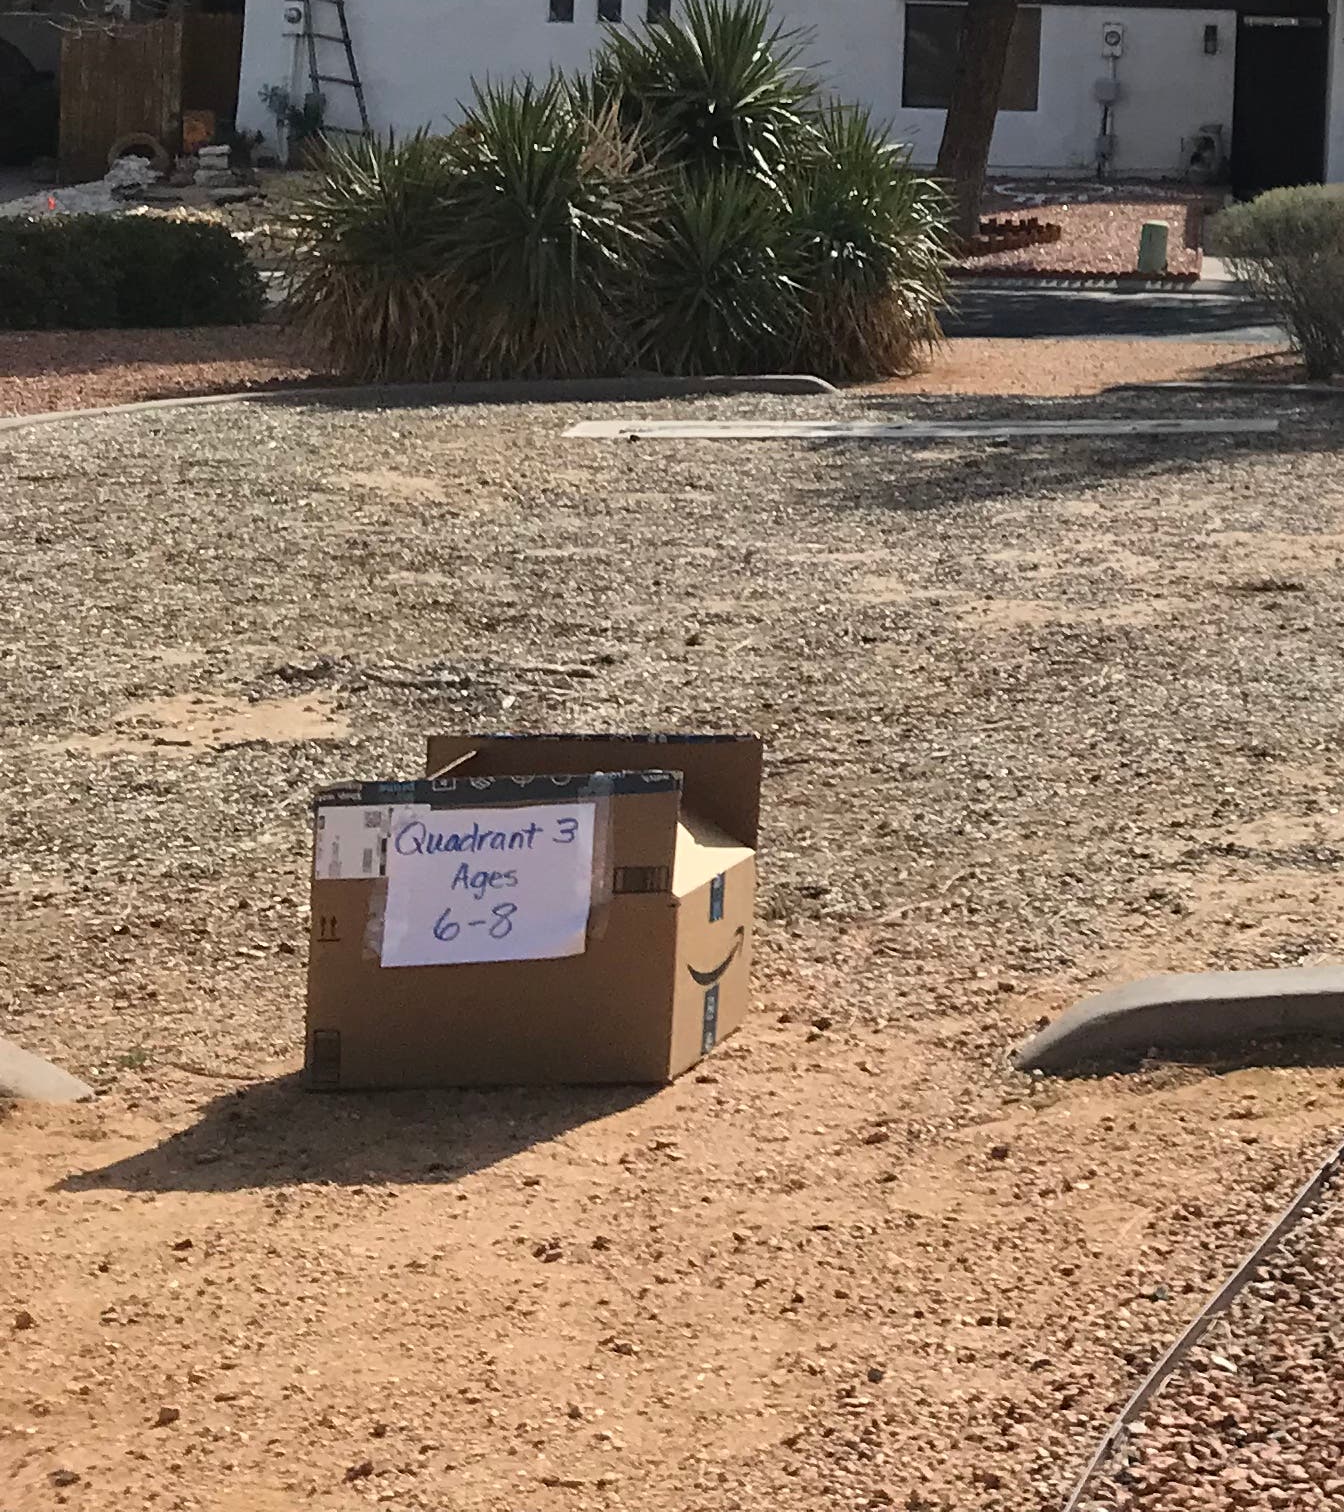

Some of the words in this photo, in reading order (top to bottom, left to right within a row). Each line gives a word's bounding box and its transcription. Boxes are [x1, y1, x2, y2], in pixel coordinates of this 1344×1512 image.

[395, 821, 543, 855] Quadrant
[552, 817, 579, 843] 3
[451, 862, 518, 900] Ages
[433, 902, 518, 941] 6-8
